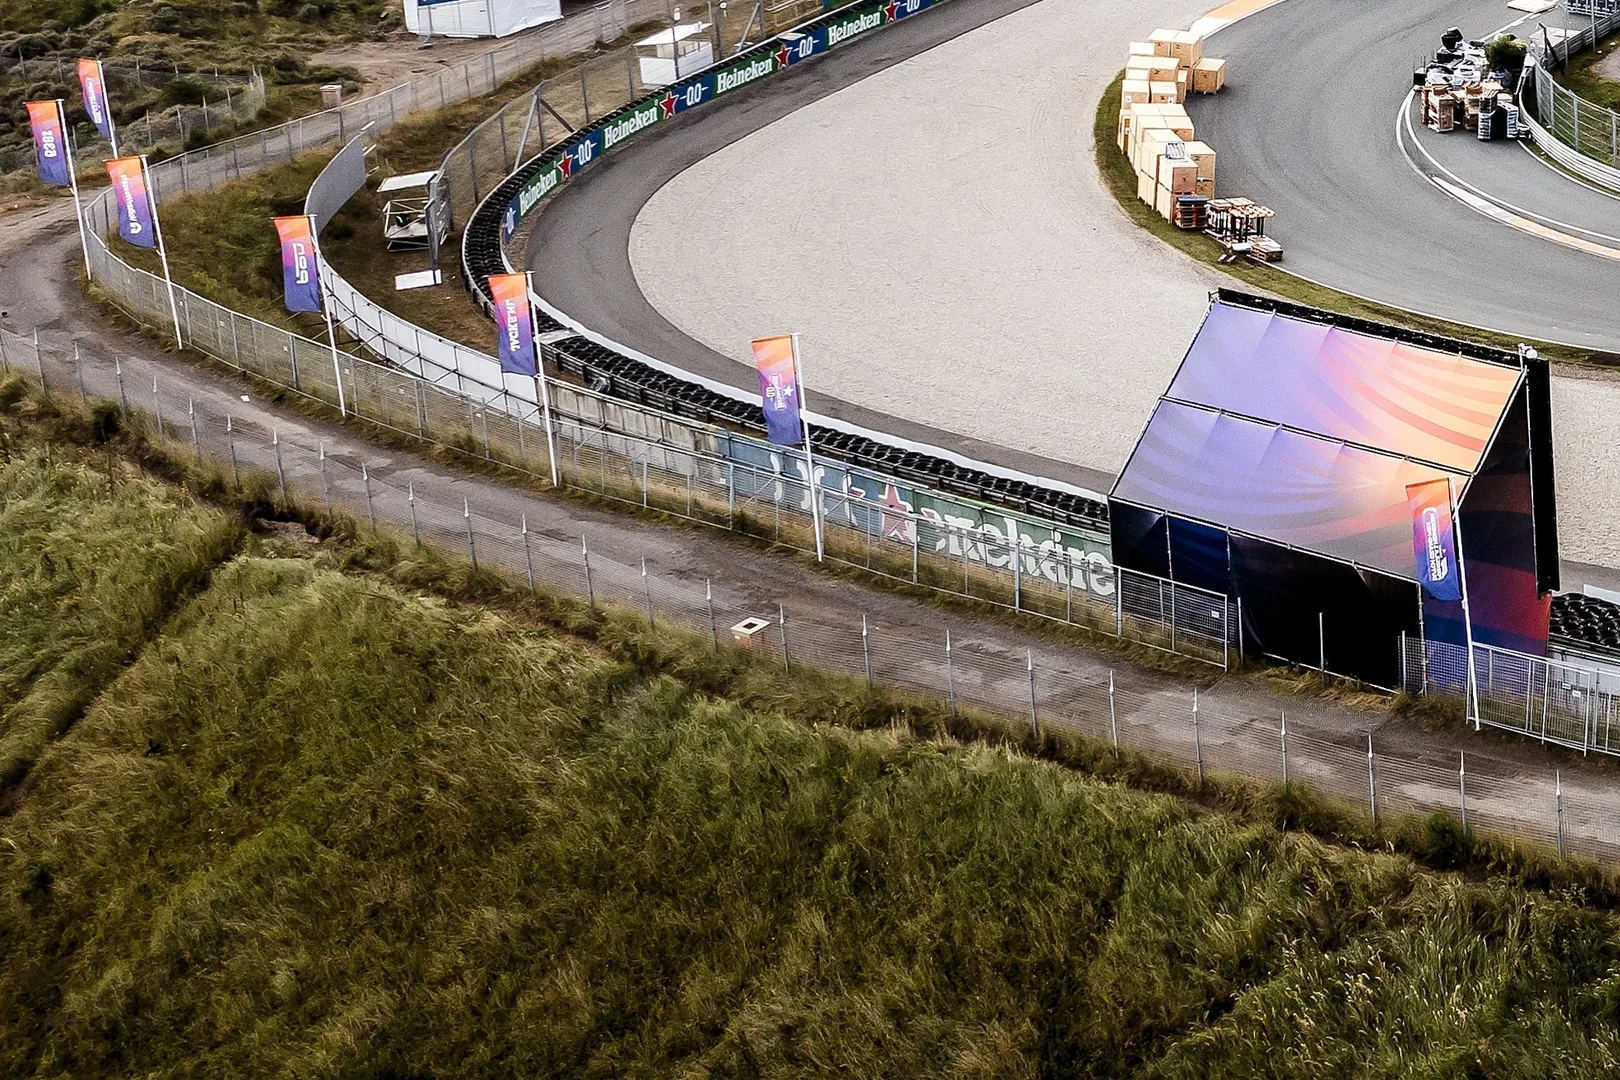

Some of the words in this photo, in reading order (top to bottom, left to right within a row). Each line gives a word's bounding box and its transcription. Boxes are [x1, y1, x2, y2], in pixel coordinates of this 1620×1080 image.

[828, 11, 880, 46] Heineken
[717, 58, 772, 94] Heineken
[604, 107, 658, 149] Heineken
[520, 168, 557, 217] Heineken
